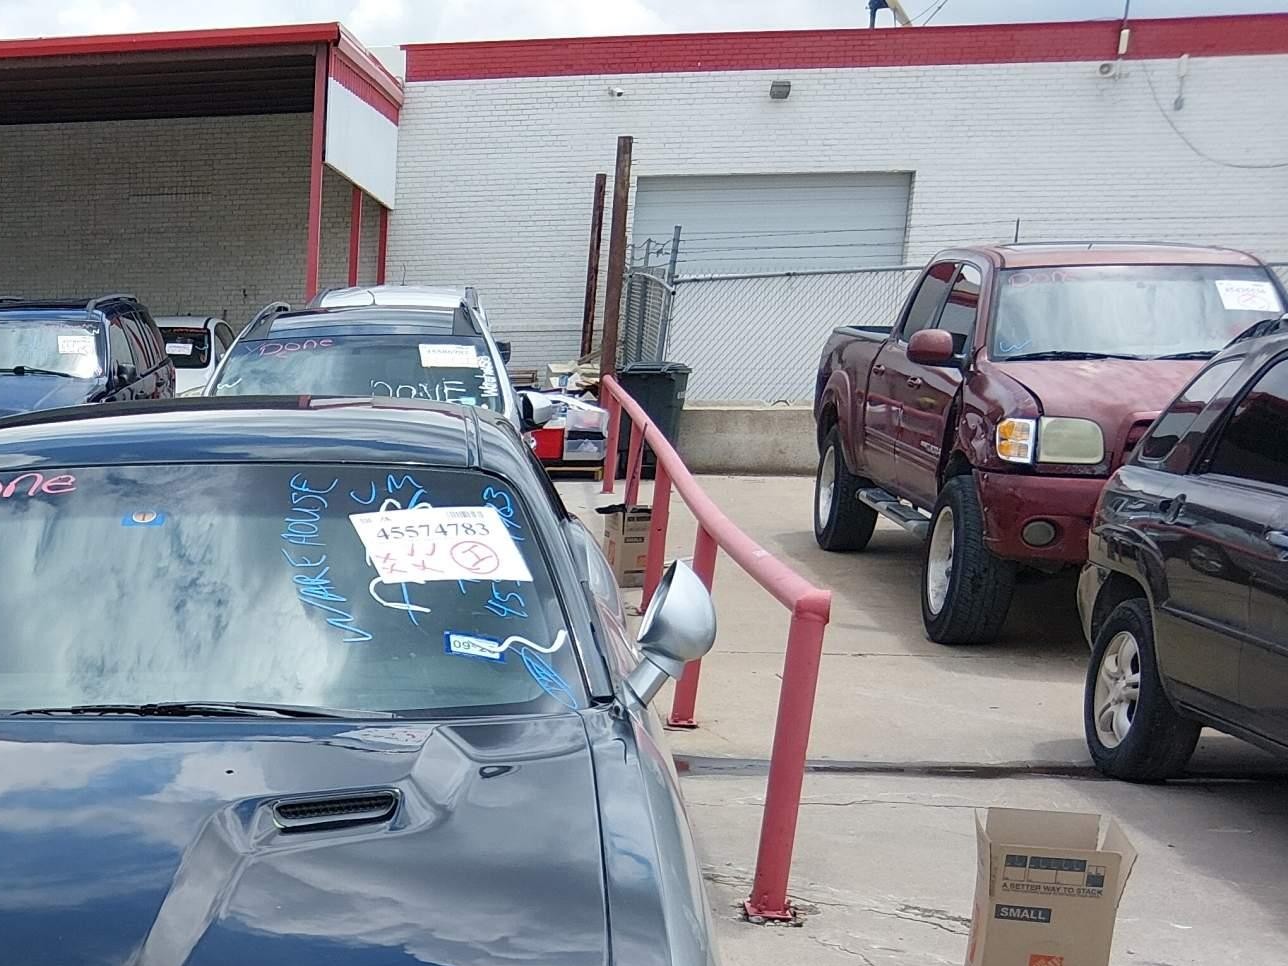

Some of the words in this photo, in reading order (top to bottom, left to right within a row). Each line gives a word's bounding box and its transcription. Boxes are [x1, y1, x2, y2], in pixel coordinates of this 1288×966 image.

[376, 522, 491, 541] 45574783
[1009, 883, 1041, 892] BETTER
[1042, 885, 1061, 893] WAY
[1076, 888, 1104, 897] STACK
[999, 907, 1047, 921] SMALL
